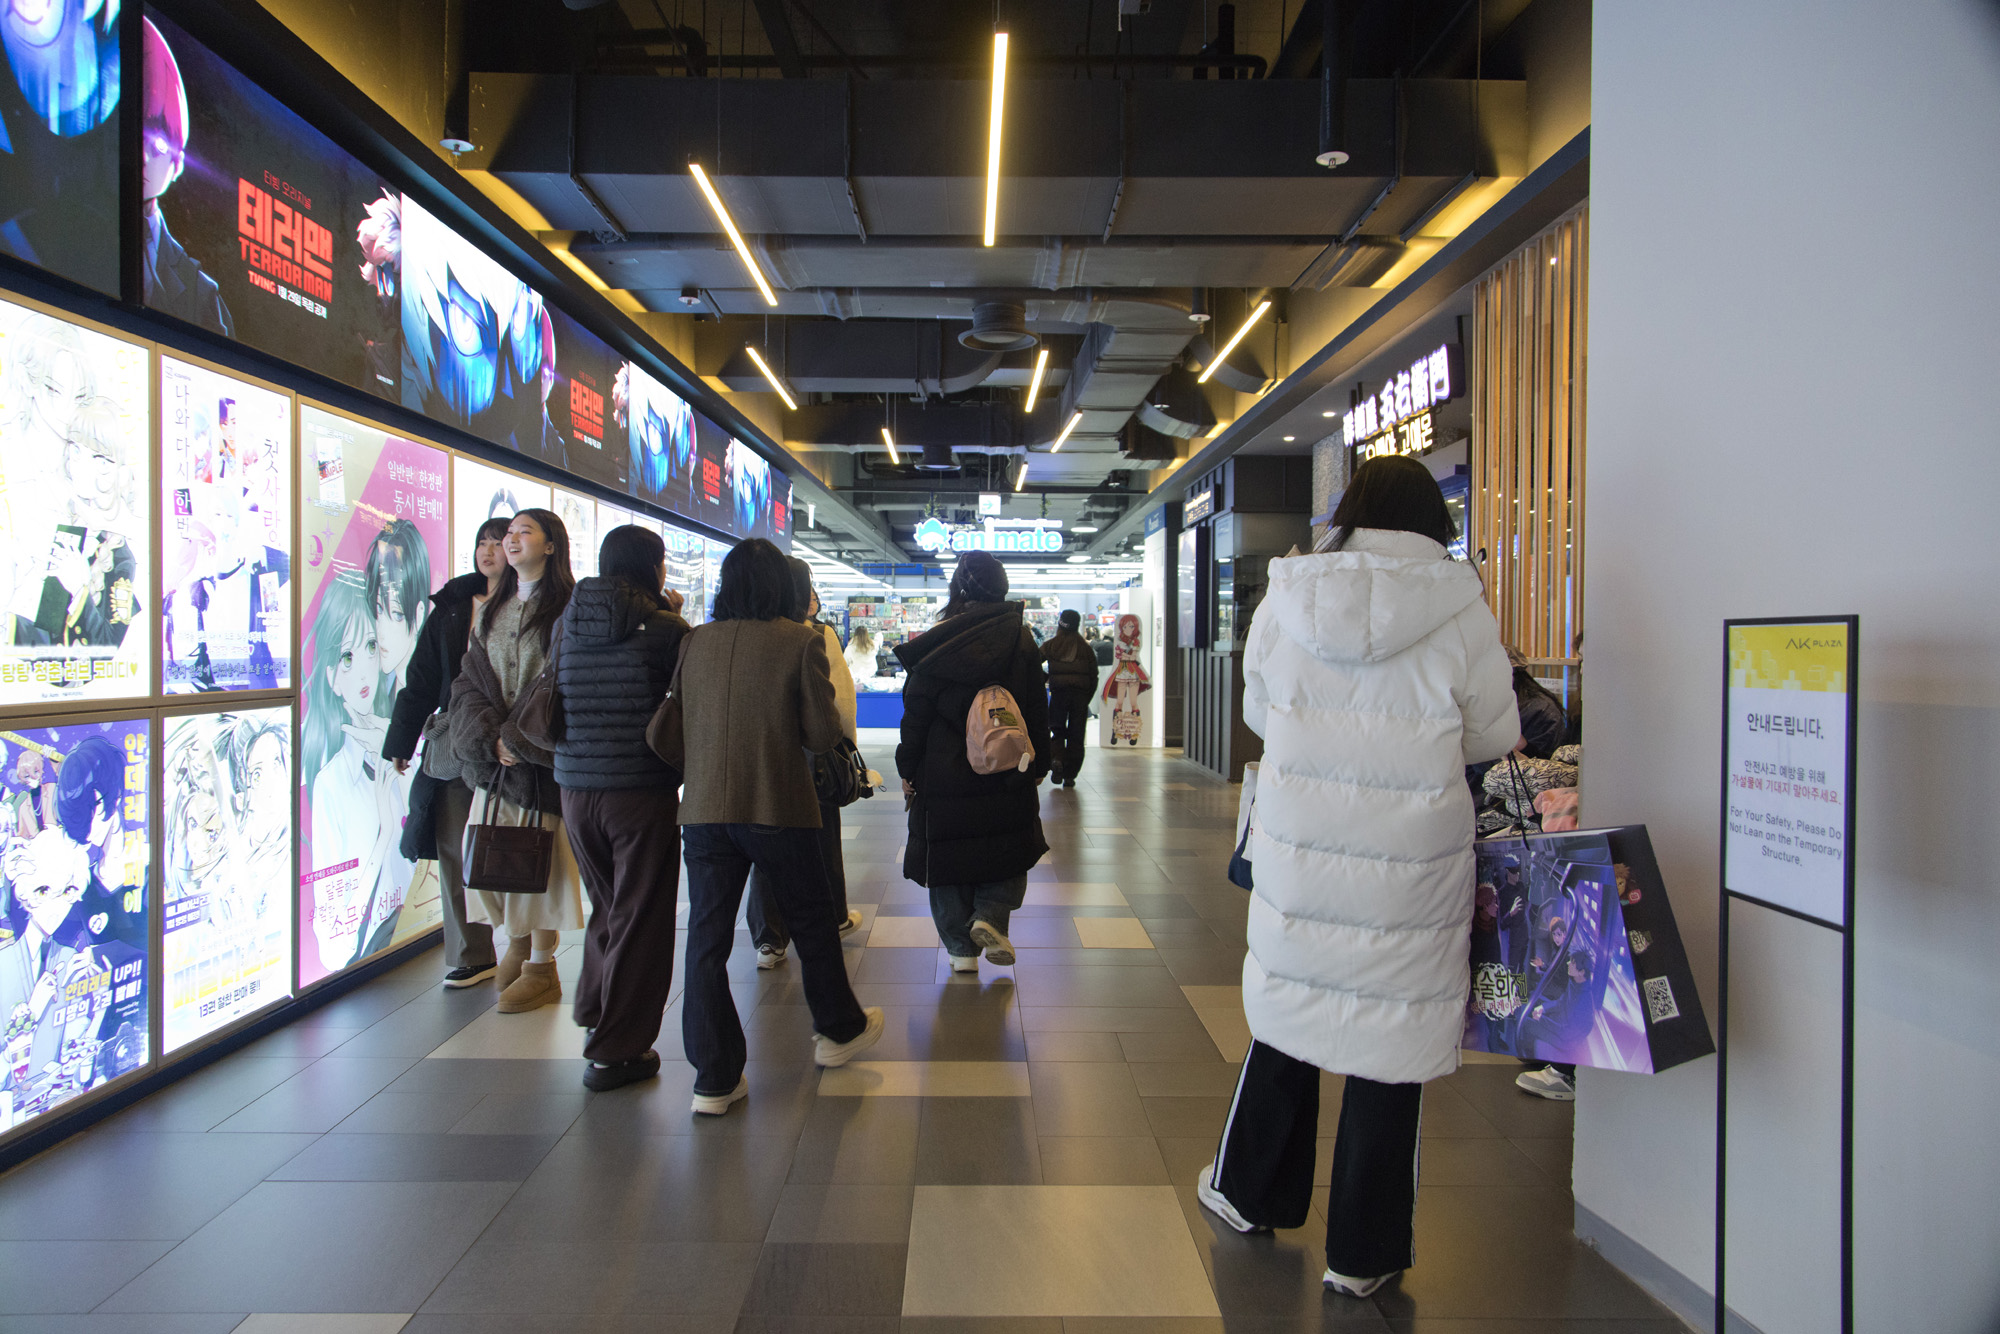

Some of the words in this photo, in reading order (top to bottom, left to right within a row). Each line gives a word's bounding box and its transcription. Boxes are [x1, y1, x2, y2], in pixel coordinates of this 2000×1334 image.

[264, 169, 280, 191] 티빙
[282, 182, 312, 210] 오리지널
[238, 177, 333, 281] 테러맨
[238, 236, 333, 304] TERRORMAN
[248, 270, 276, 294] TVING
[277, 284, 288, 301] 1월
[301, 297, 314, 314] 독점
[314, 302, 328, 320] 공개
[570, 377, 604, 426] 테러맨
[1379, 343, 1450, 432] 五右衛門
[175, 384, 190, 430] 나와
[1399, 412, 1433, 457] 고에몬
[175, 437, 190, 483] 다시
[319, 462, 343, 481] SAMPLE
[393, 489, 415, 517] 동시
[417, 495, 443, 521] 발매!!
[952, 517, 1062, 551] animate
[1785, 637, 1811, 650] AK
[1813, 639, 1842, 648] PLAZA
[0, 663, 30, 683] 탕탕
[34, 661, 63, 682] 청춘
[65, 660, 91, 680] 러브
[94, 661, 129, 679] 코미디
[1747, 712, 1824, 740] 안내드립니다.
[125, 733, 147, 822] 얀데레
[1732, 773, 1763, 792] 가설물에
[1766, 779, 1791, 795] 기대지
[1793, 784, 1842, 805] 말아주세요.
[1744, 760, 1777, 776] 안전사고
[1779, 765, 1806, 781] 예방을
[1808, 768, 1826, 785] 위해
[1729, 821, 1742, 833] Not
[1743, 824, 1763, 839] Lean
[1765, 831, 1776, 842] on
[1778, 833, 1792, 846] the
[1794, 835, 1842, 861] Temporary
[1730, 806, 1743, 817] For
[1745, 808, 1763, 822] Your
[1765, 812, 1794, 832] Safety,
[1796, 819, 1826, 836] Please
[1829, 826, 1842, 840] Do
[1761, 844, 1803, 867] Structure.
[326, 878, 359, 901] 달콤하고
[329, 898, 372, 940] 소문의
[114, 959, 142, 983] UP!!
[53, 998, 90, 1027] 대망의
[92, 990, 113, 1012] 2권
[115, 979, 142, 1003] 발매!
[198, 999, 215, 1018] 13권
[217, 992, 231, 1010] 절찬
[233, 984, 247, 1003] 판매
